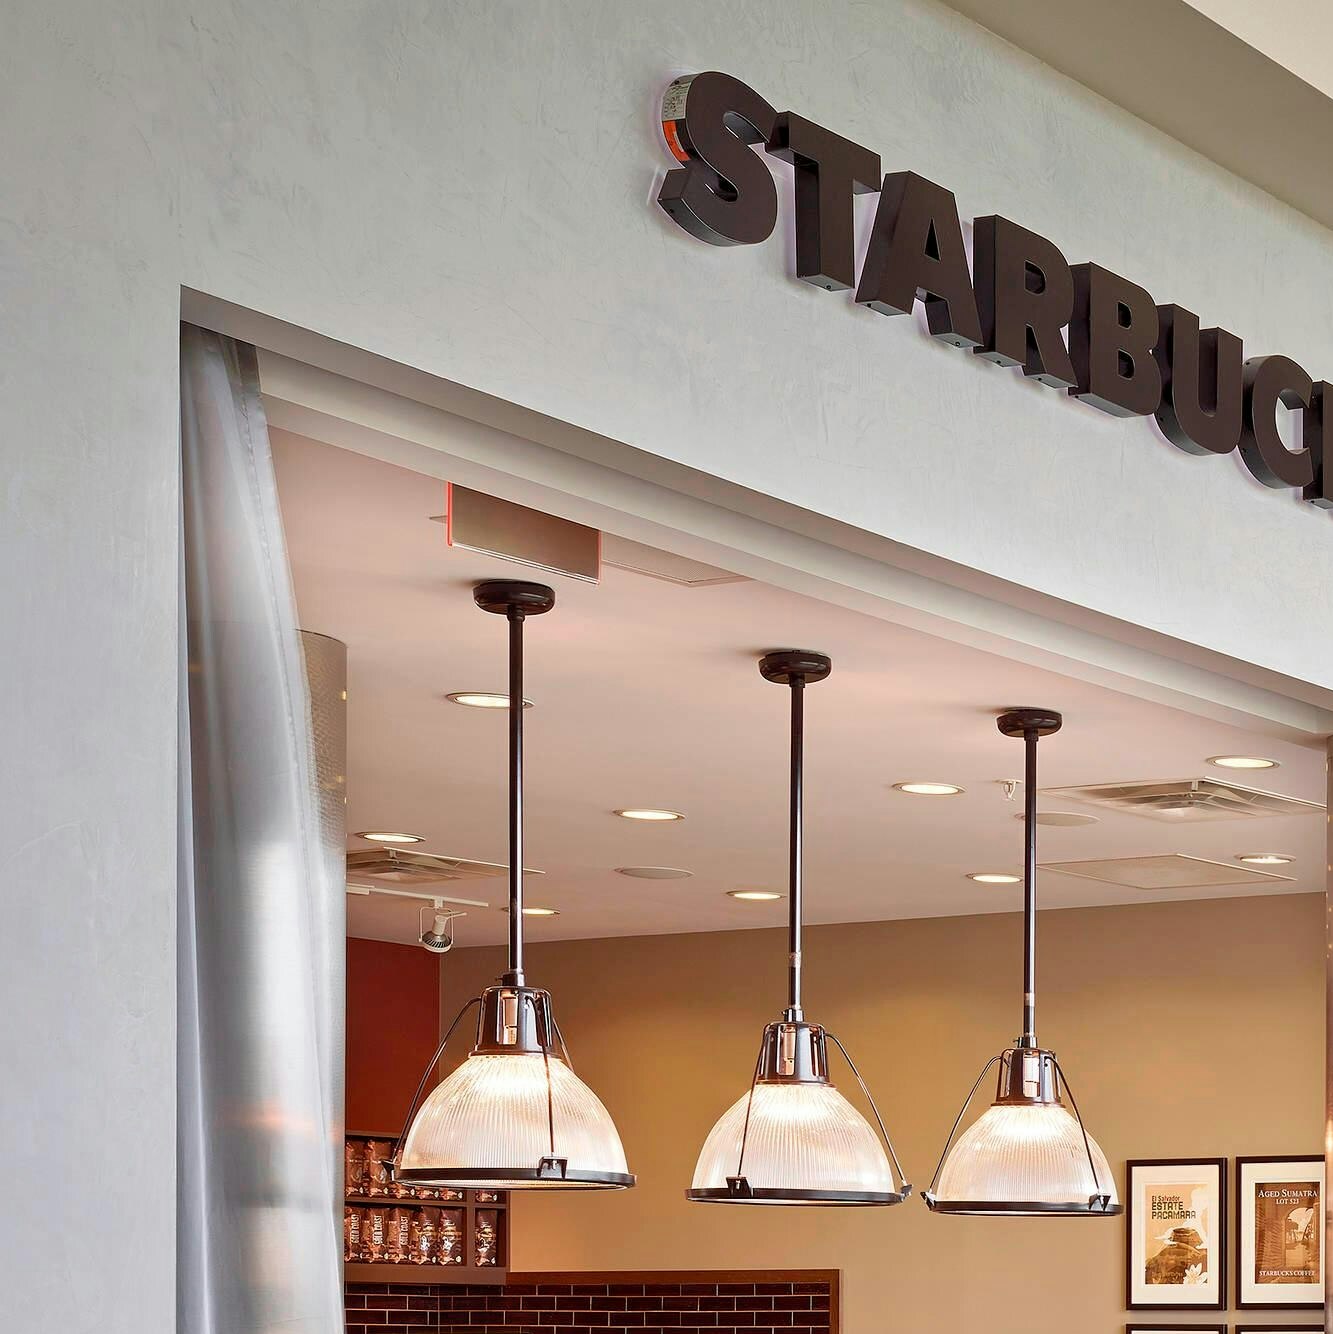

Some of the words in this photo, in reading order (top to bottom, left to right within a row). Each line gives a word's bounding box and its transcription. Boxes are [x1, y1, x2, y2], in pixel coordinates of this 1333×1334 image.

[1258, 1189, 1280, 1198] AGED
[1281, 1188, 1318, 1198] SUMATRA
[1151, 1201, 1184, 1211] ESTATE
[1151, 1210, 1197, 1220] PACAMARA
